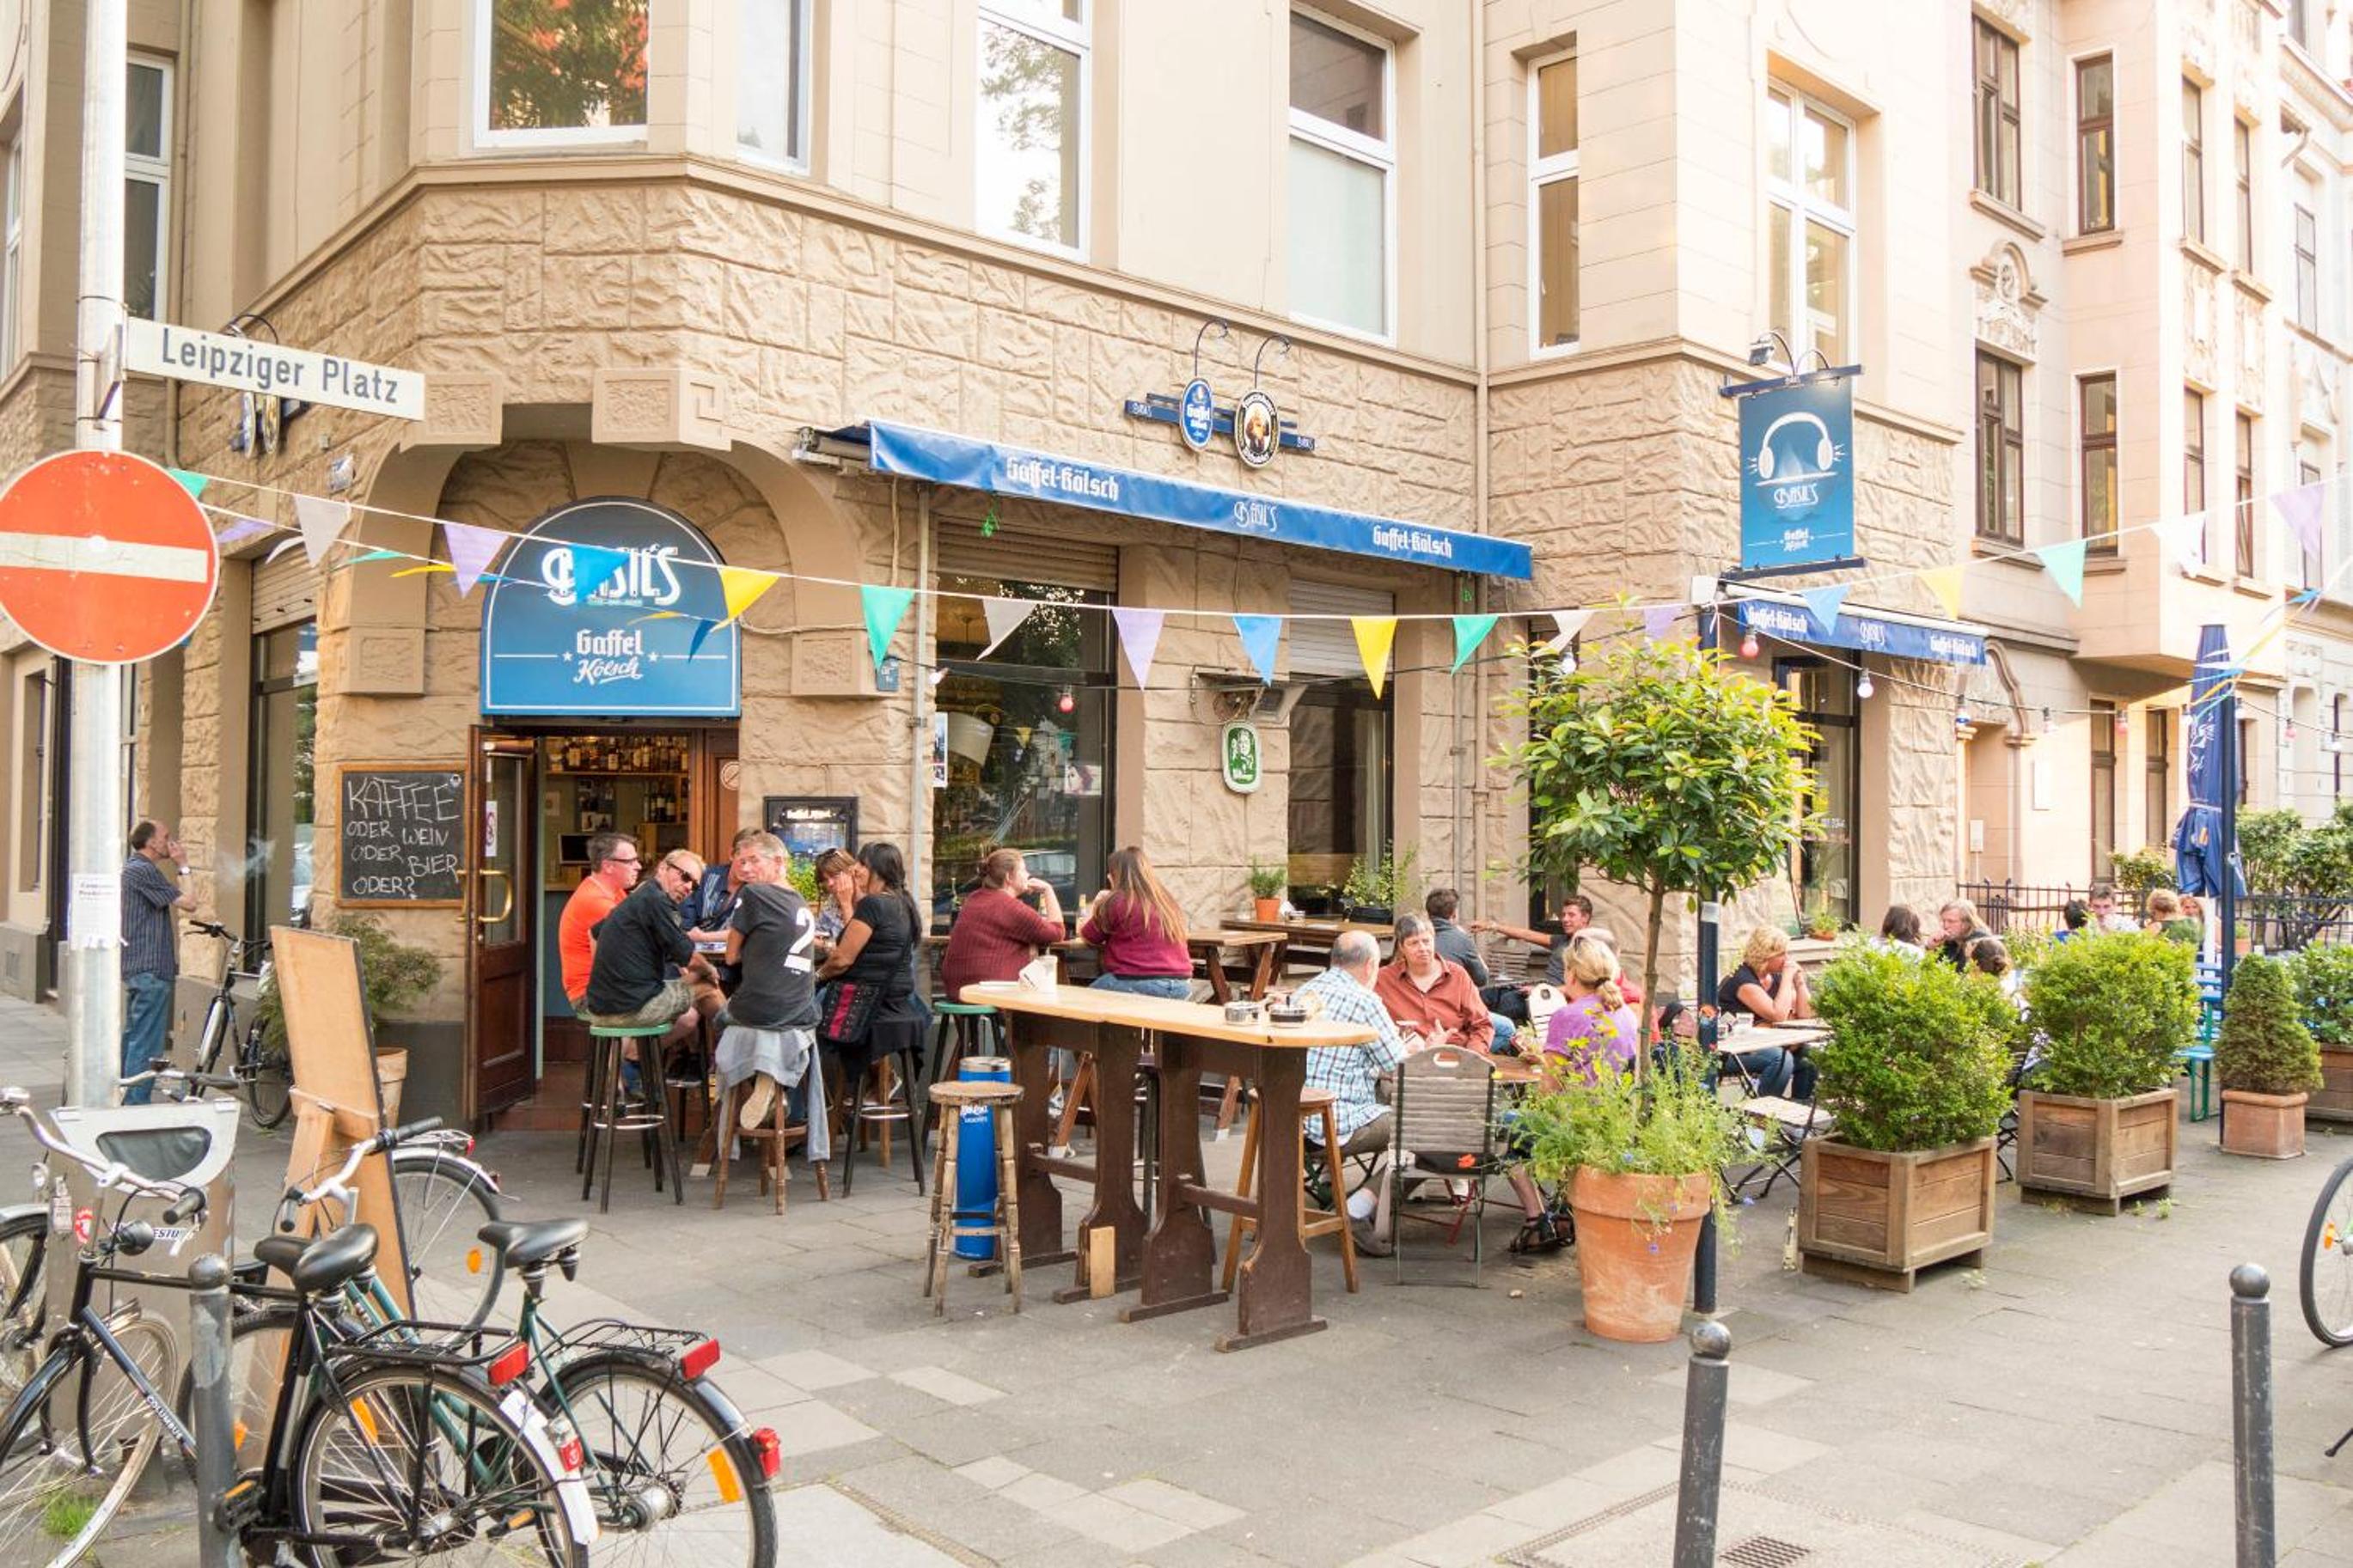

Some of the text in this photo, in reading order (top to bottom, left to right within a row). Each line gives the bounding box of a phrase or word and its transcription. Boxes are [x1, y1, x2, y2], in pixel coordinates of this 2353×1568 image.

[162, 327, 398, 403] Leipziger Platz
[1006, 456, 1119, 502] Gaffel-Kölsch
[1373, 525, 1452, 559] Gaffel-Kölsch
[577, 629, 644, 657] Gaffel
[573, 656, 644, 686] Kölsch
[348, 777, 460, 823] KAFFEE
[346, 820, 449, 846] ODER WEIN
[351, 845, 459, 883] ODER BIER
[352, 876, 418, 900] ODER?
[784, 907, 816, 973] 2
